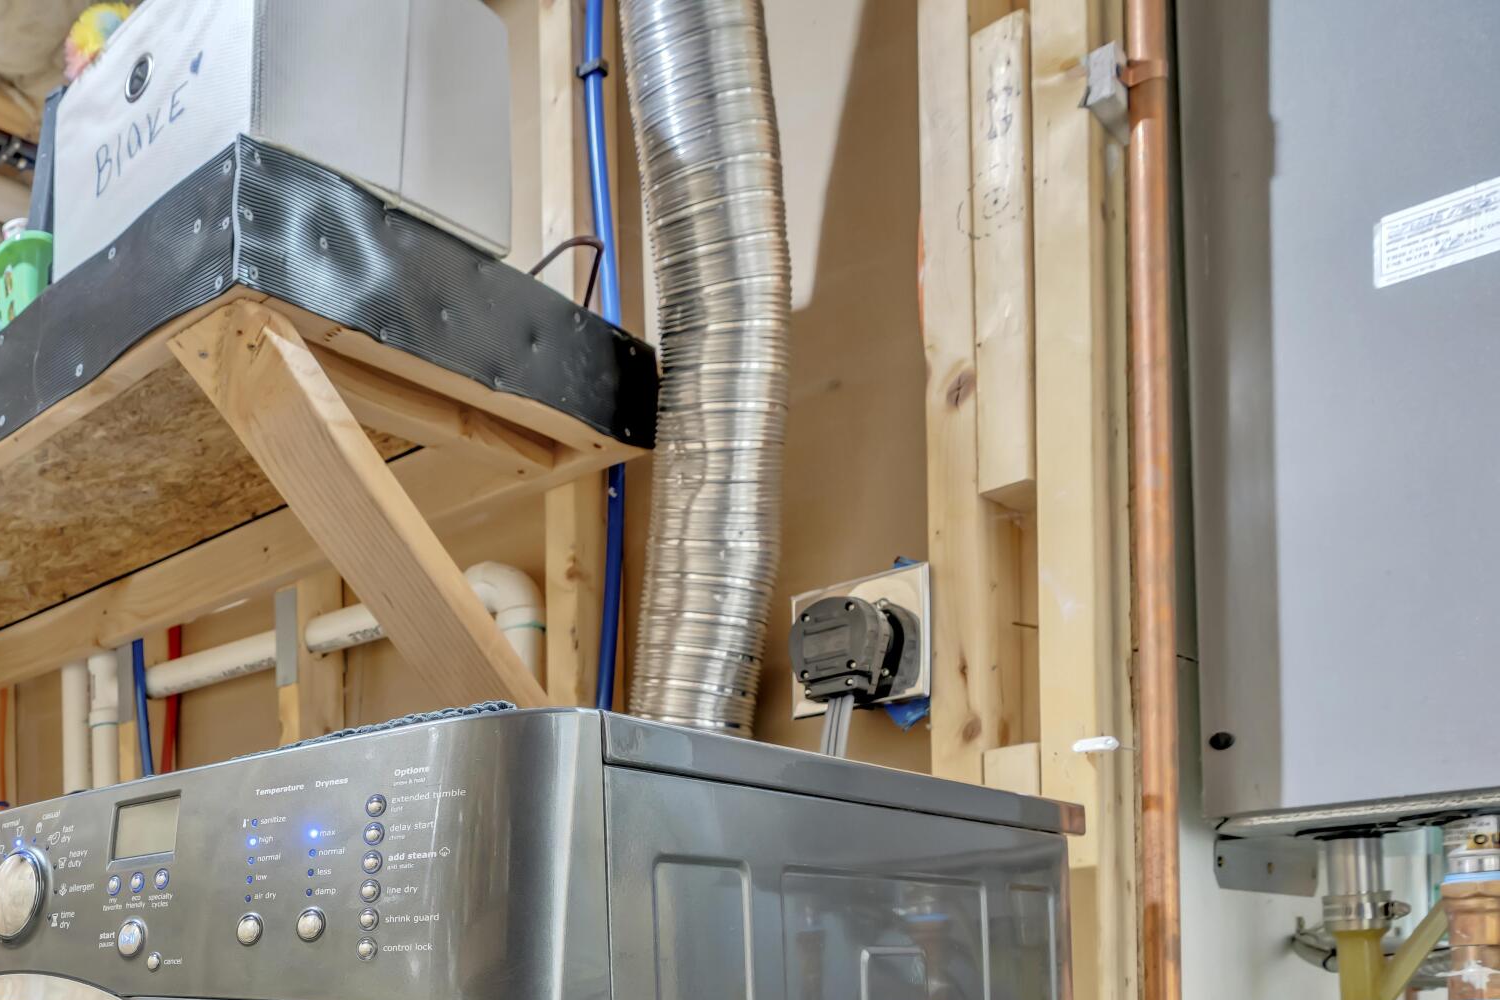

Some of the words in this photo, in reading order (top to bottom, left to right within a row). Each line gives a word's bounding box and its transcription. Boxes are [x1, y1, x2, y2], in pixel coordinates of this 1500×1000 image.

[394, 766, 430, 778] Options
[315, 777, 349, 788] Dryness
[255, 783, 305, 796] Temperature
[391, 792, 430, 804] extended
[432, 788, 467, 799] tumble
[260, 815, 287, 825] sanitize
[62, 824, 74, 832] fast
[389, 822, 411, 832] delay
[414, 821, 435, 830] start
[60, 834, 72, 844] dry
[258, 834, 274, 845] high
[69, 849, 89, 858] heavy
[318, 847, 345, 856] normal
[387, 852, 405, 862] add
[407, 851, 437, 861] steam
[257, 852, 281, 863] normal
[67, 859, 83, 869] duty
[317, 867, 332, 875] less
[255, 873, 268, 881] low
[68, 883, 95, 893] allergen
[314, 887, 337, 896] damp
[386, 886, 401, 894] line
[404, 884, 418, 894] dry
[148, 892, 173, 902] specialty
[254, 892, 263, 900] air
[265, 891, 277, 900] dry
[102, 904, 122, 912] favorite
[125, 901, 145, 909] friendly
[151, 901, 169, 909] cycles
[60, 911, 75, 919] time
[385, 914, 411, 924] shrink
[413, 913, 440, 924] guard
[60, 920, 71, 929] dry
[99, 931, 116, 940] start
[98, 941, 115, 949] pause
[382, 943, 413, 953] control
[415, 942, 433, 951] lock
[163, 957, 183, 965] cancel
